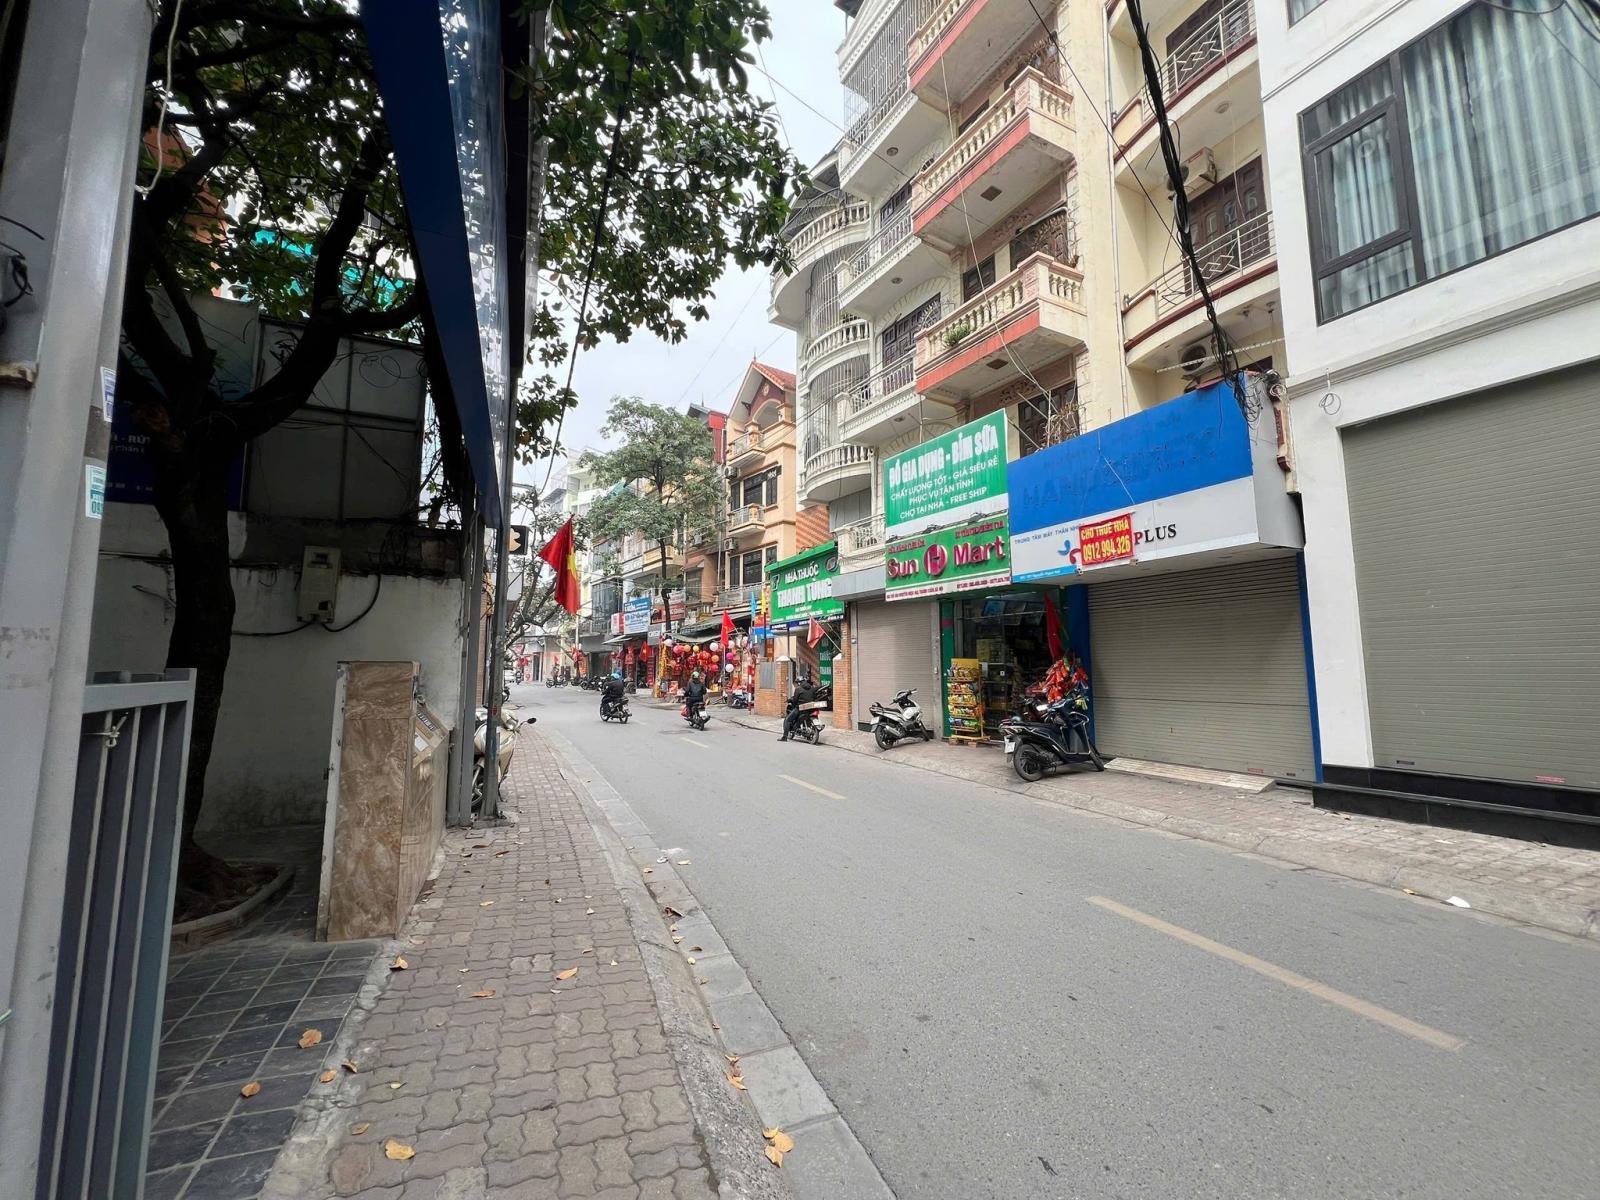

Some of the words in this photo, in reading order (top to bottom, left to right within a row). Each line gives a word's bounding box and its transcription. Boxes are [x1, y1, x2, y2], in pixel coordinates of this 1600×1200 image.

[902, 458, 918, 483] GIA
[918, 447, 945, 480] DỤNG
[974, 424, 998, 456] SỮA
[934, 474, 947, 485] TỐT
[969, 461, 986, 474] SIÊU
[949, 491, 968, 504] FREE
[968, 486, 987, 499] SHIP
[1134, 523, 1177, 546] PLUS
[887, 557, 919, 578] Sun
[953, 536, 1006, 566] Mart
[797, 561, 819, 581] THUỐC
